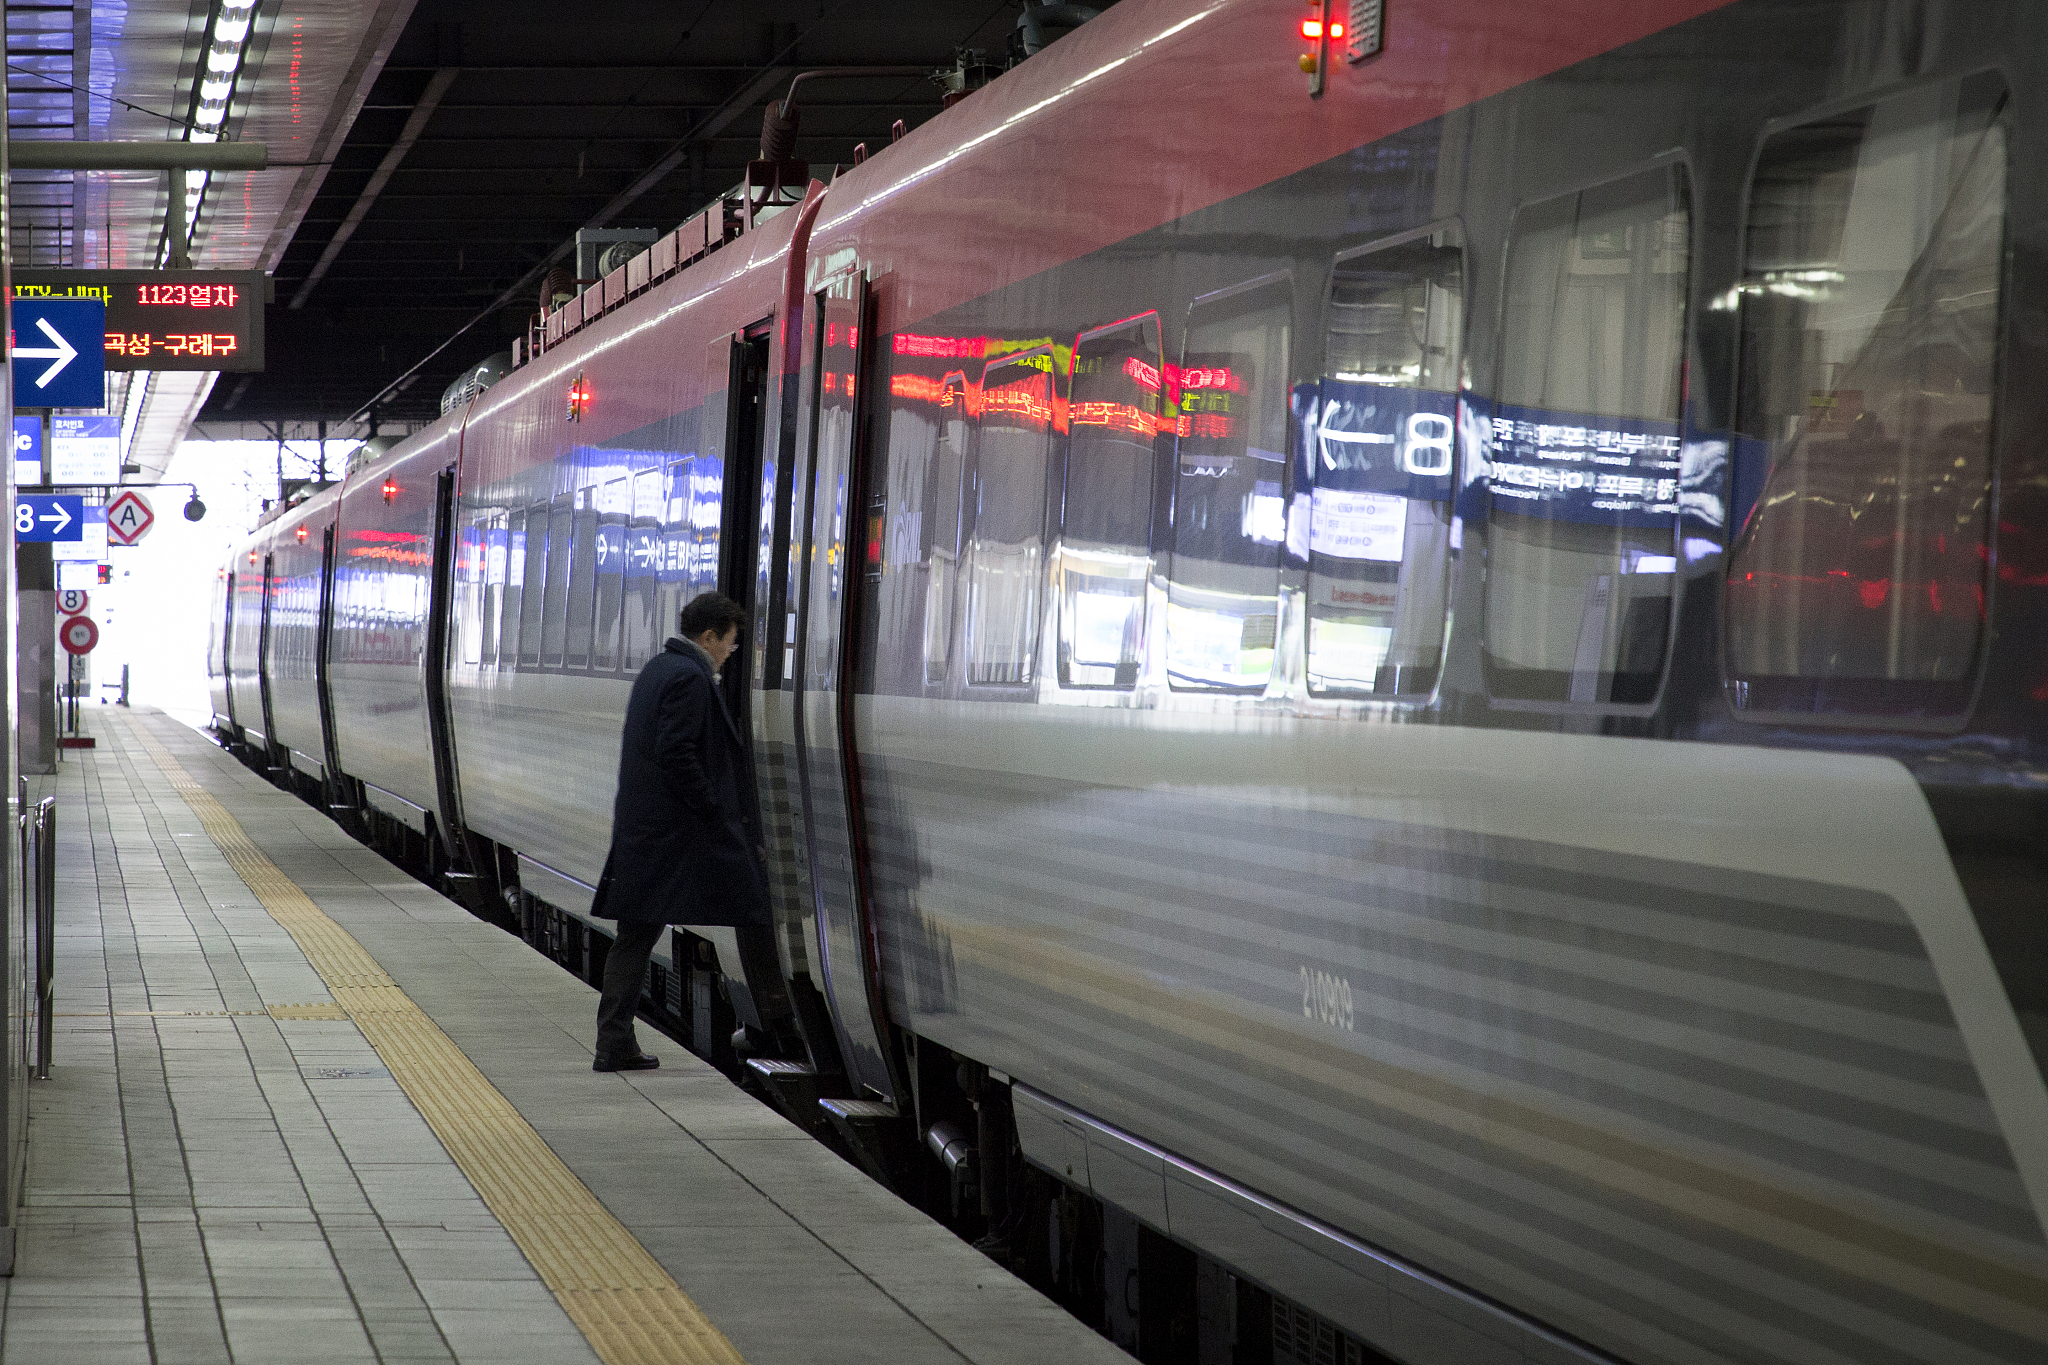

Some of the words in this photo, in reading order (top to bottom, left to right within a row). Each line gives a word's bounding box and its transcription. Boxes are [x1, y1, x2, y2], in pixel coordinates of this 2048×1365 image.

[138, 285, 239, 307] 1123열차
[104, 333, 237, 356] 곡성-구례구
[119, 505, 137, 526] A
[65, 590, 77, 608] 8
